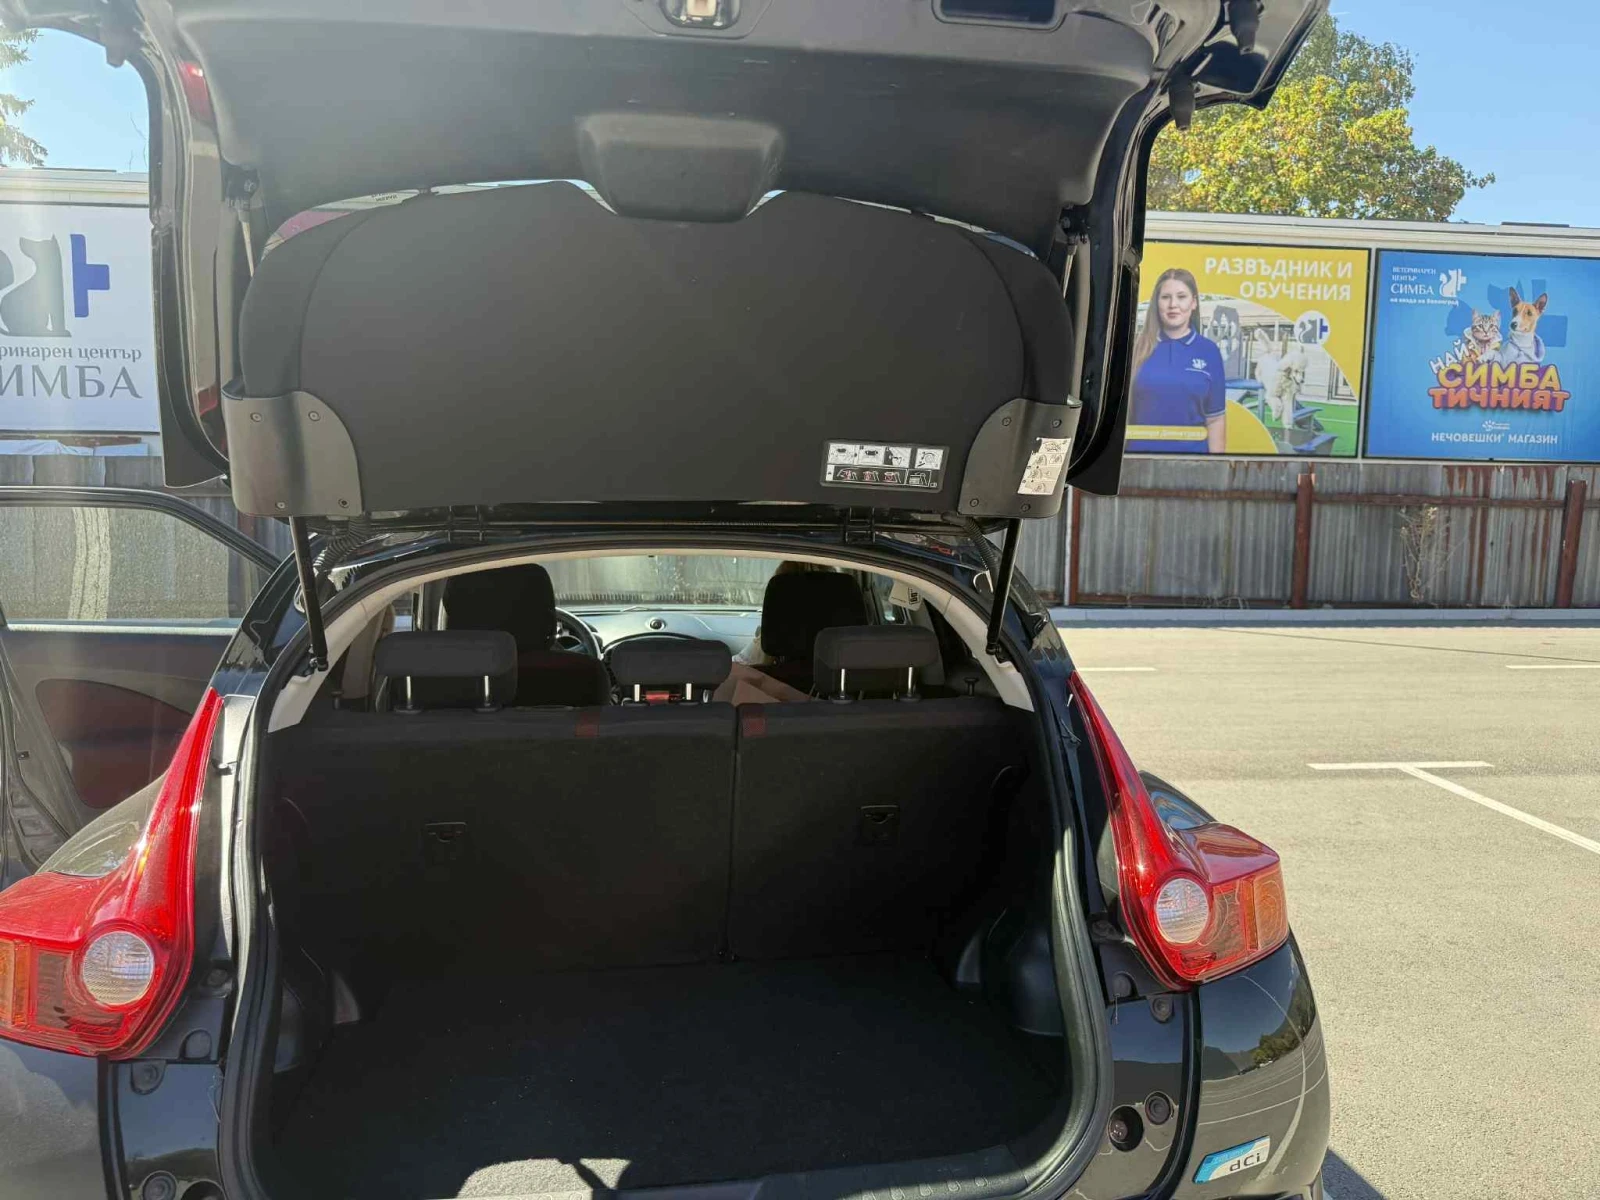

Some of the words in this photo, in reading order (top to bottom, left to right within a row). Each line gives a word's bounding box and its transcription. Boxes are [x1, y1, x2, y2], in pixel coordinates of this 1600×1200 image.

[1204, 257, 1332, 281] РАЗВЪДНИК
[1337, 262, 1353, 279] И
[1239, 281, 1351, 301] ОБУЧЕНИЯ
[1390, 282, 1434, 295] СИМБА
[77, 347, 142, 363] център
[1438, 362, 1561, 391] СИМБА
[1429, 388, 1570, 411] ТИЧНИЯТ
[1507, 434, 1558, 444] МАГАЗИН
[1229, 1152, 1261, 1172] dCi
